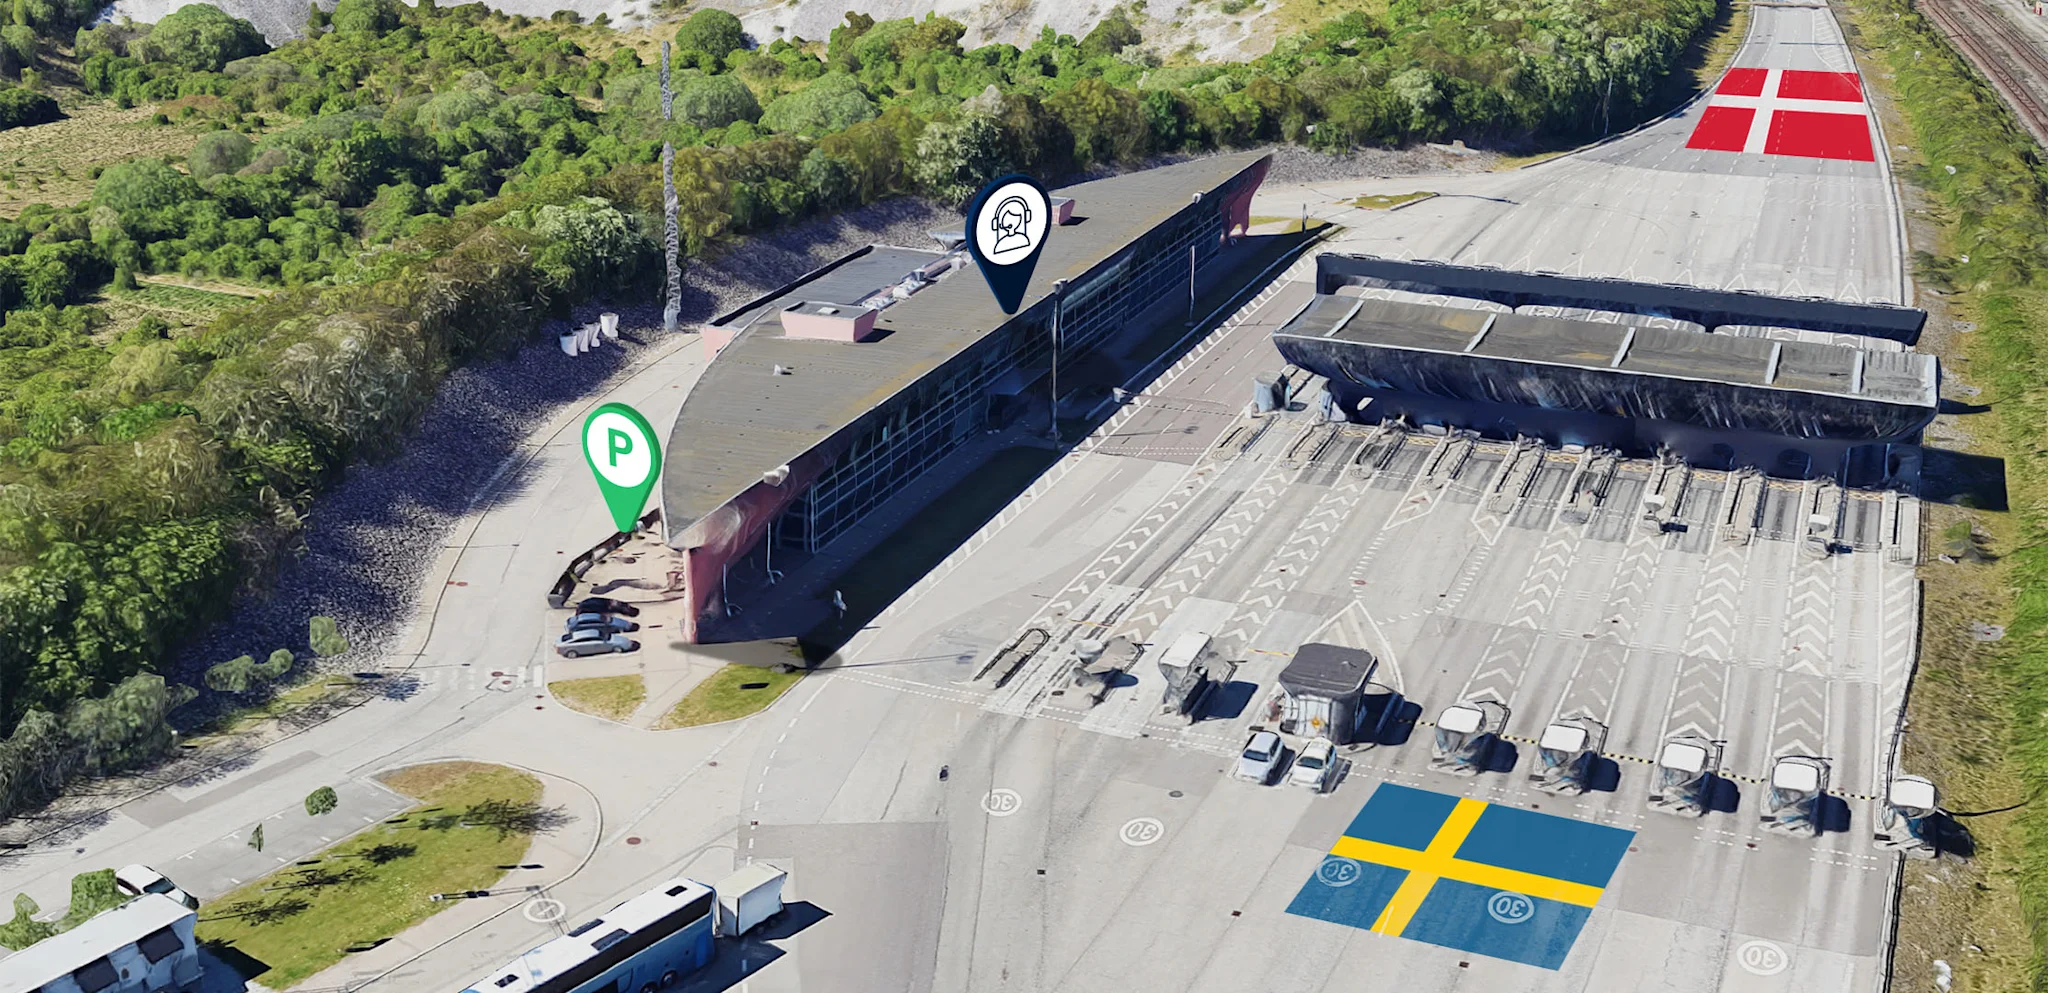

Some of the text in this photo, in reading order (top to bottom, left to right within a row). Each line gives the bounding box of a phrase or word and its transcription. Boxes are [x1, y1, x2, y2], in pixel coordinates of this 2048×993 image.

[990, 794, 1013, 811] 30
[1127, 822, 1157, 840] 30
[1496, 898, 1525, 918] 30
[1746, 946, 1777, 968] 30
